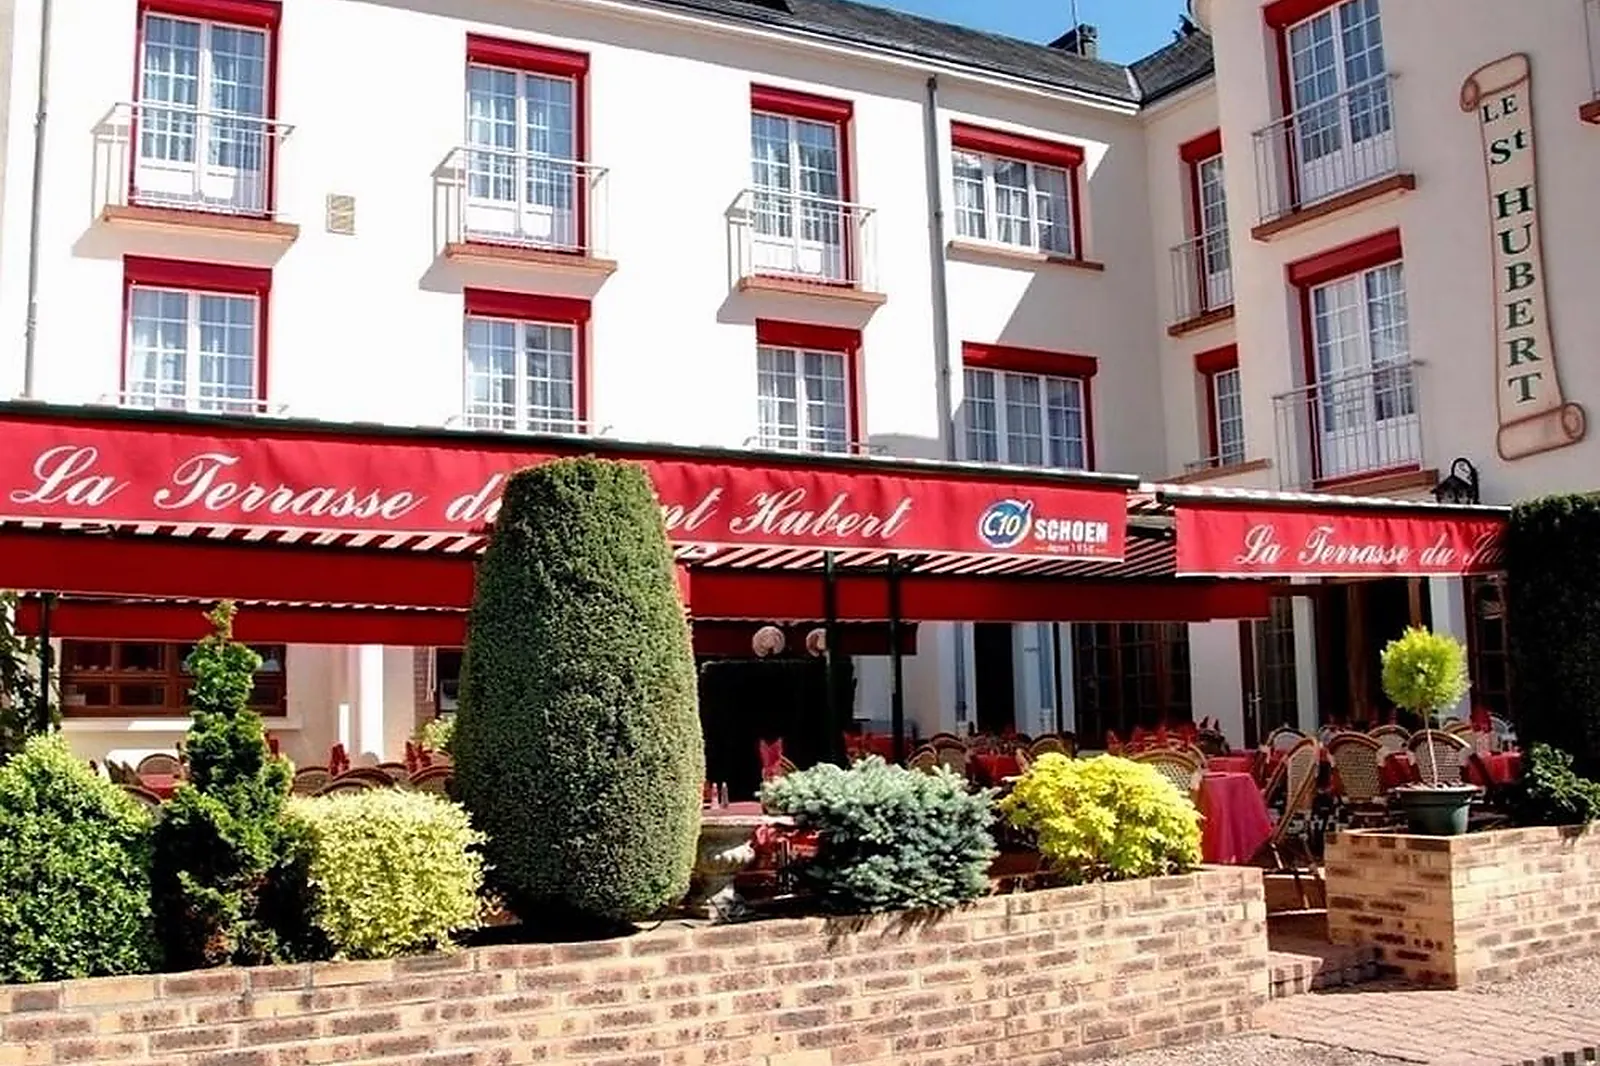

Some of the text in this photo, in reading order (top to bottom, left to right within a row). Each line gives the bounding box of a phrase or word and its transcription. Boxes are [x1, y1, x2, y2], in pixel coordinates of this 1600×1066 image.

[1482, 94, 1543, 403] LE St HUBERT
[9, 445, 129, 507] La
[153, 453, 424, 520] Terrasse
[729, 487, 912, 538] Hubert
[1033, 519, 1109, 543] SCHOEN
[1233, 524, 1289, 565] La
[1298, 526, 1411, 566] Terrasse
[1420, 532, 1458, 567] du
